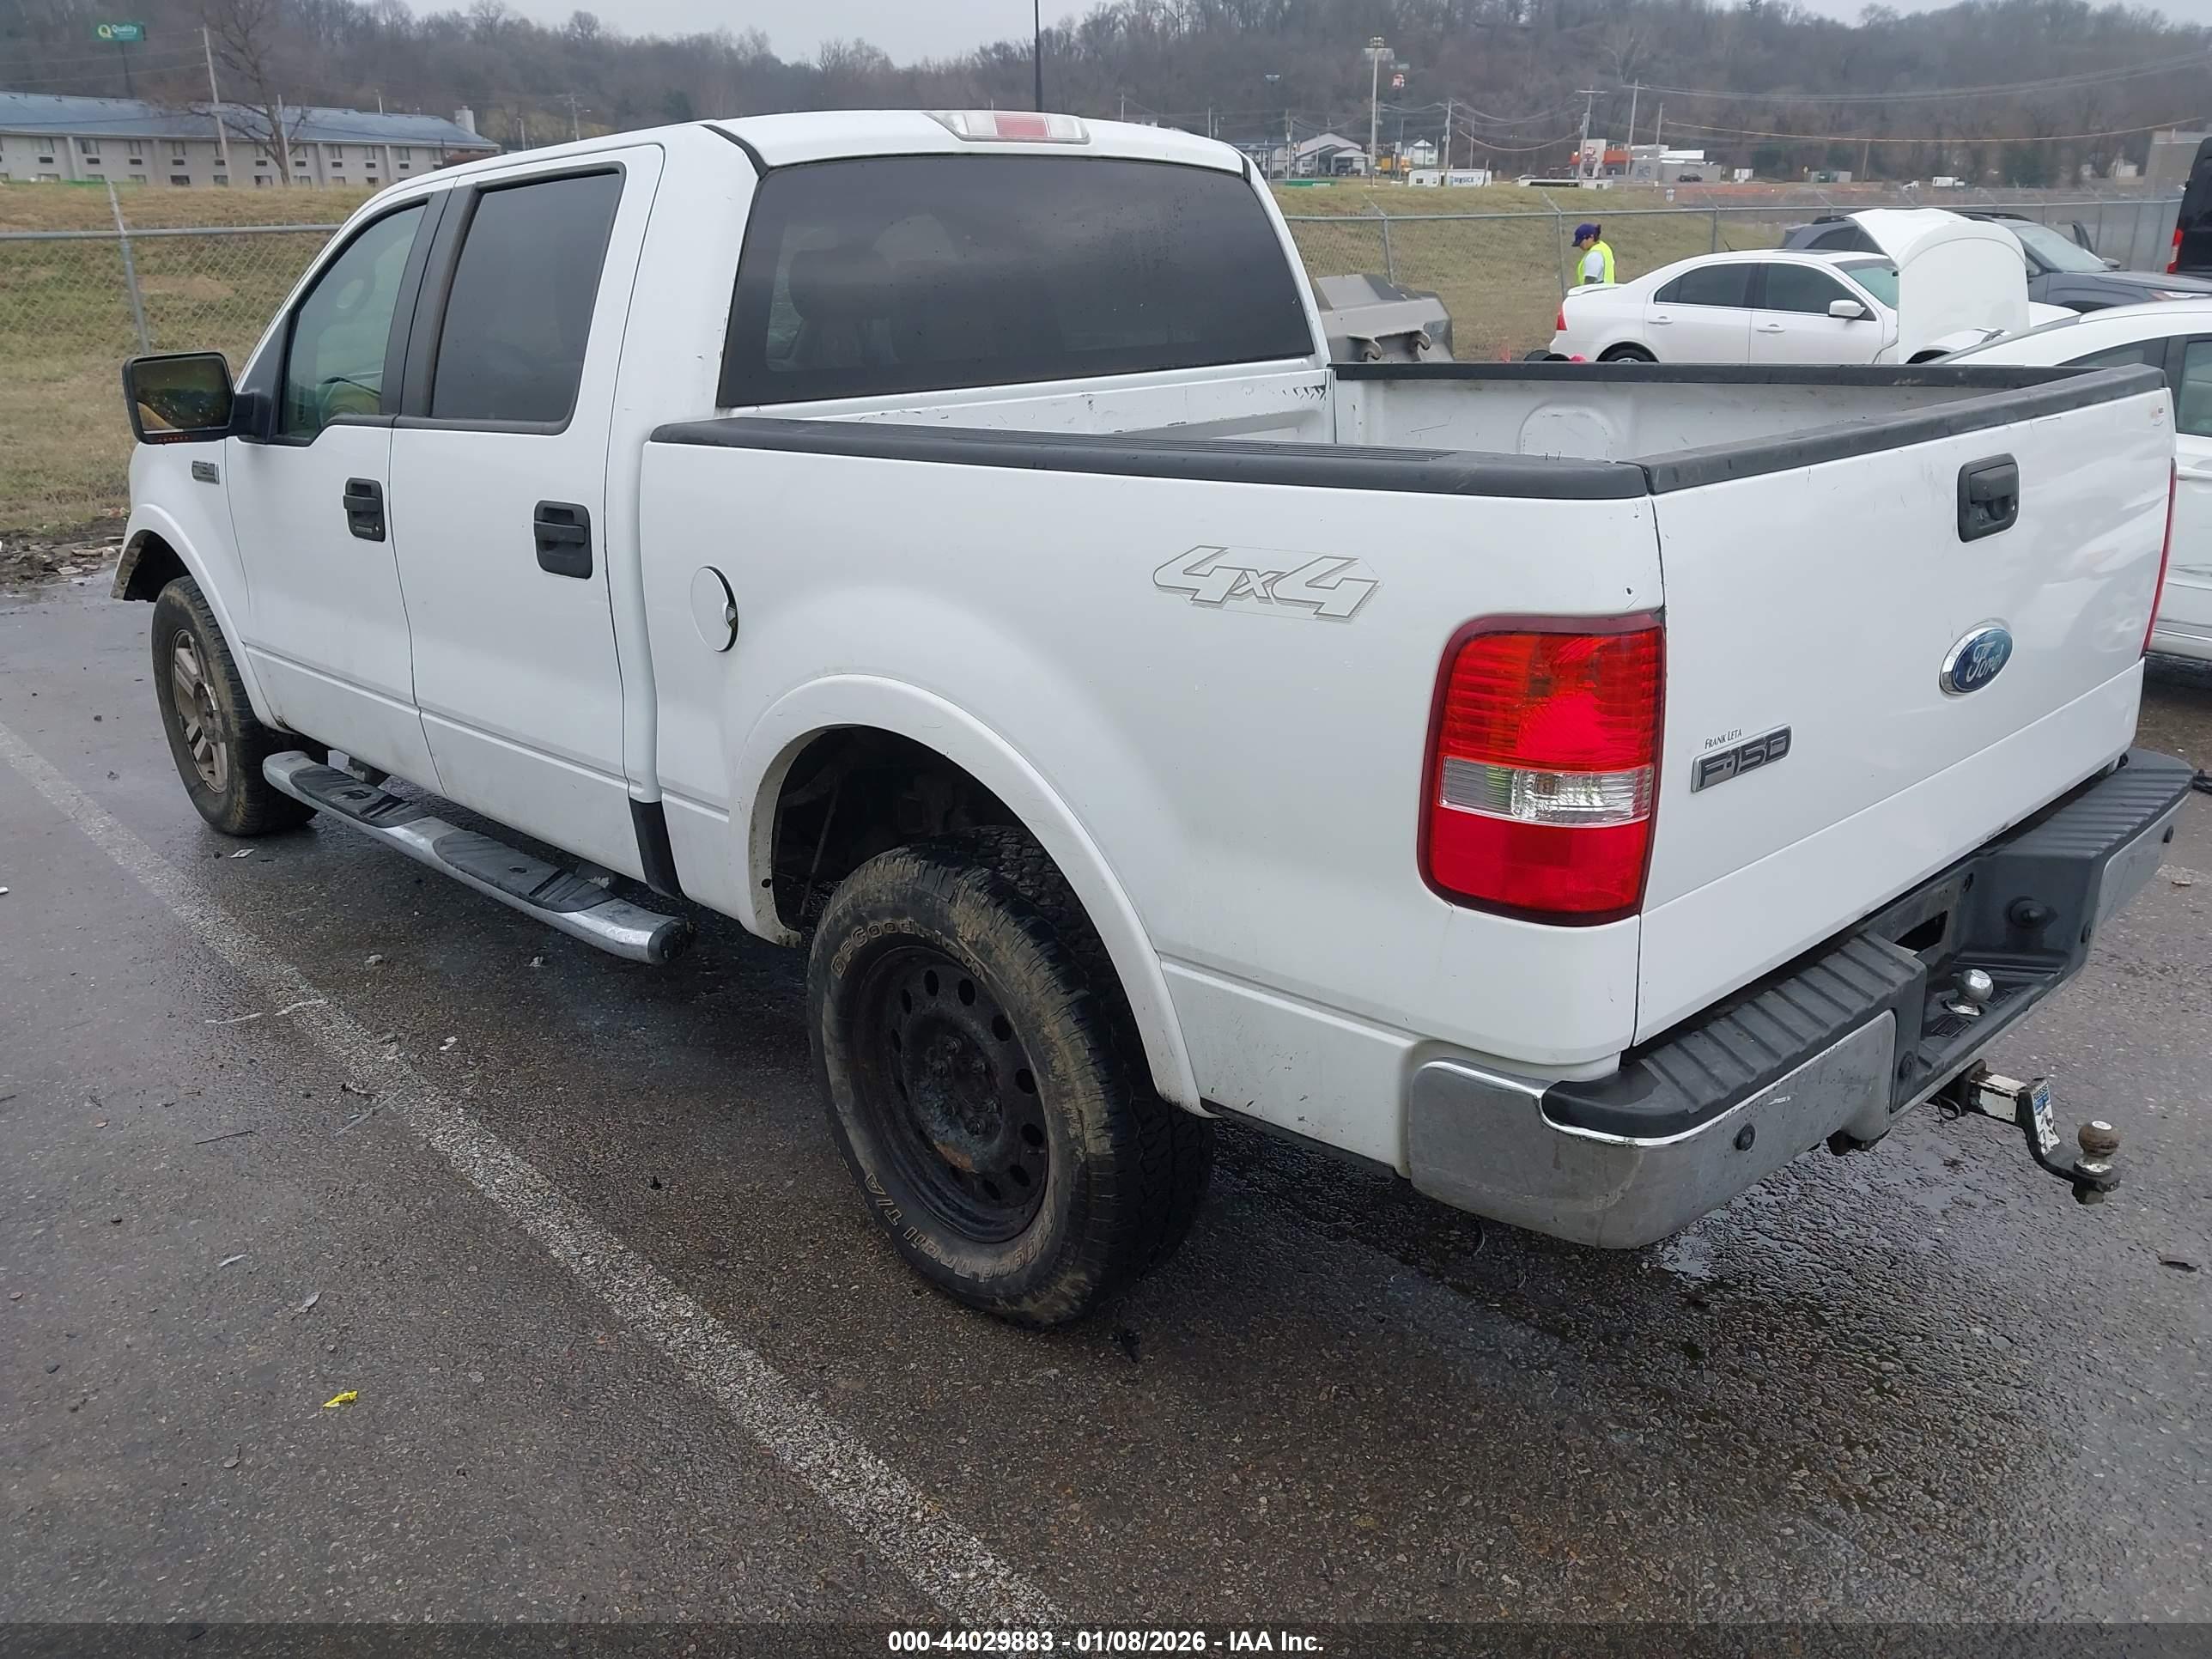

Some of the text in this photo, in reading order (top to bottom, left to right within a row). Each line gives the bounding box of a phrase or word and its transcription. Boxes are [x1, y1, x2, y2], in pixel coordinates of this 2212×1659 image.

[1966, 640, 2005, 684] Ford
[1705, 727, 1742, 750] FRANK LETA
[864, 1171, 905, 1227] T/A
[902, 1226, 975, 1280] Trail
